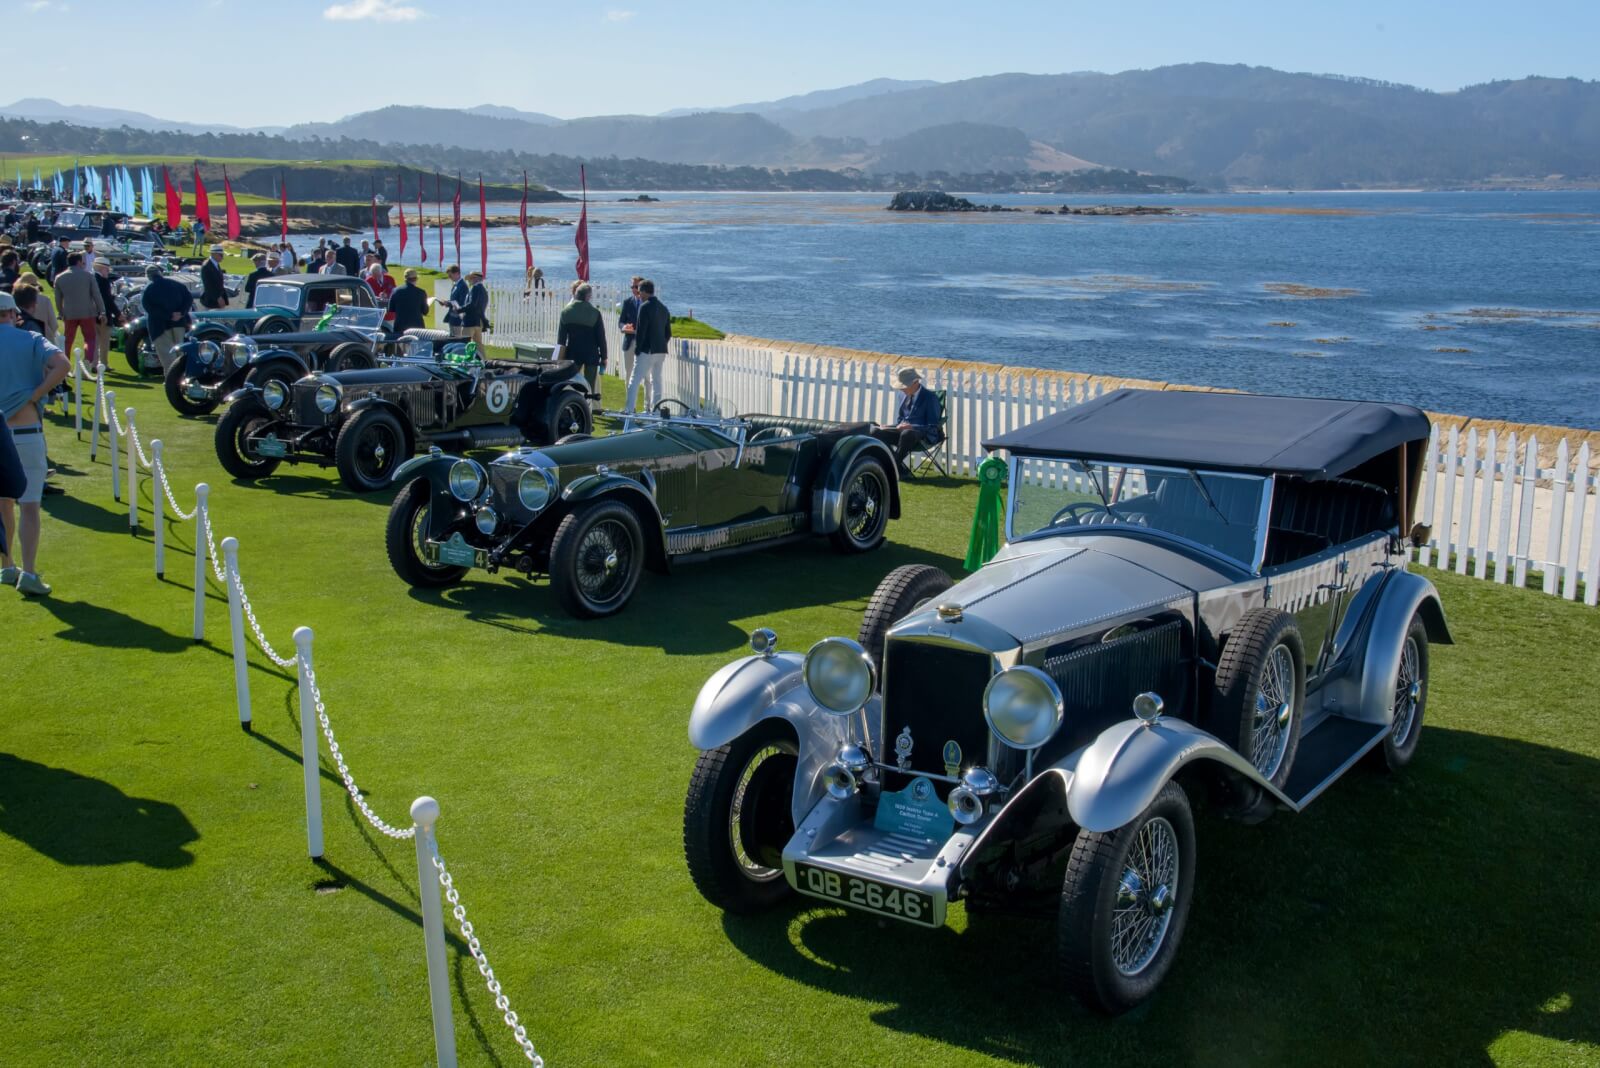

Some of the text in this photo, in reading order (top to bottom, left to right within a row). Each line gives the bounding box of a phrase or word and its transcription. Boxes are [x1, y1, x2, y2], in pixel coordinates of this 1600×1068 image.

[492, 385, 503, 408] 6
[476, 552, 484, 567] 4
[807, 868, 922, 918] QB 2646
